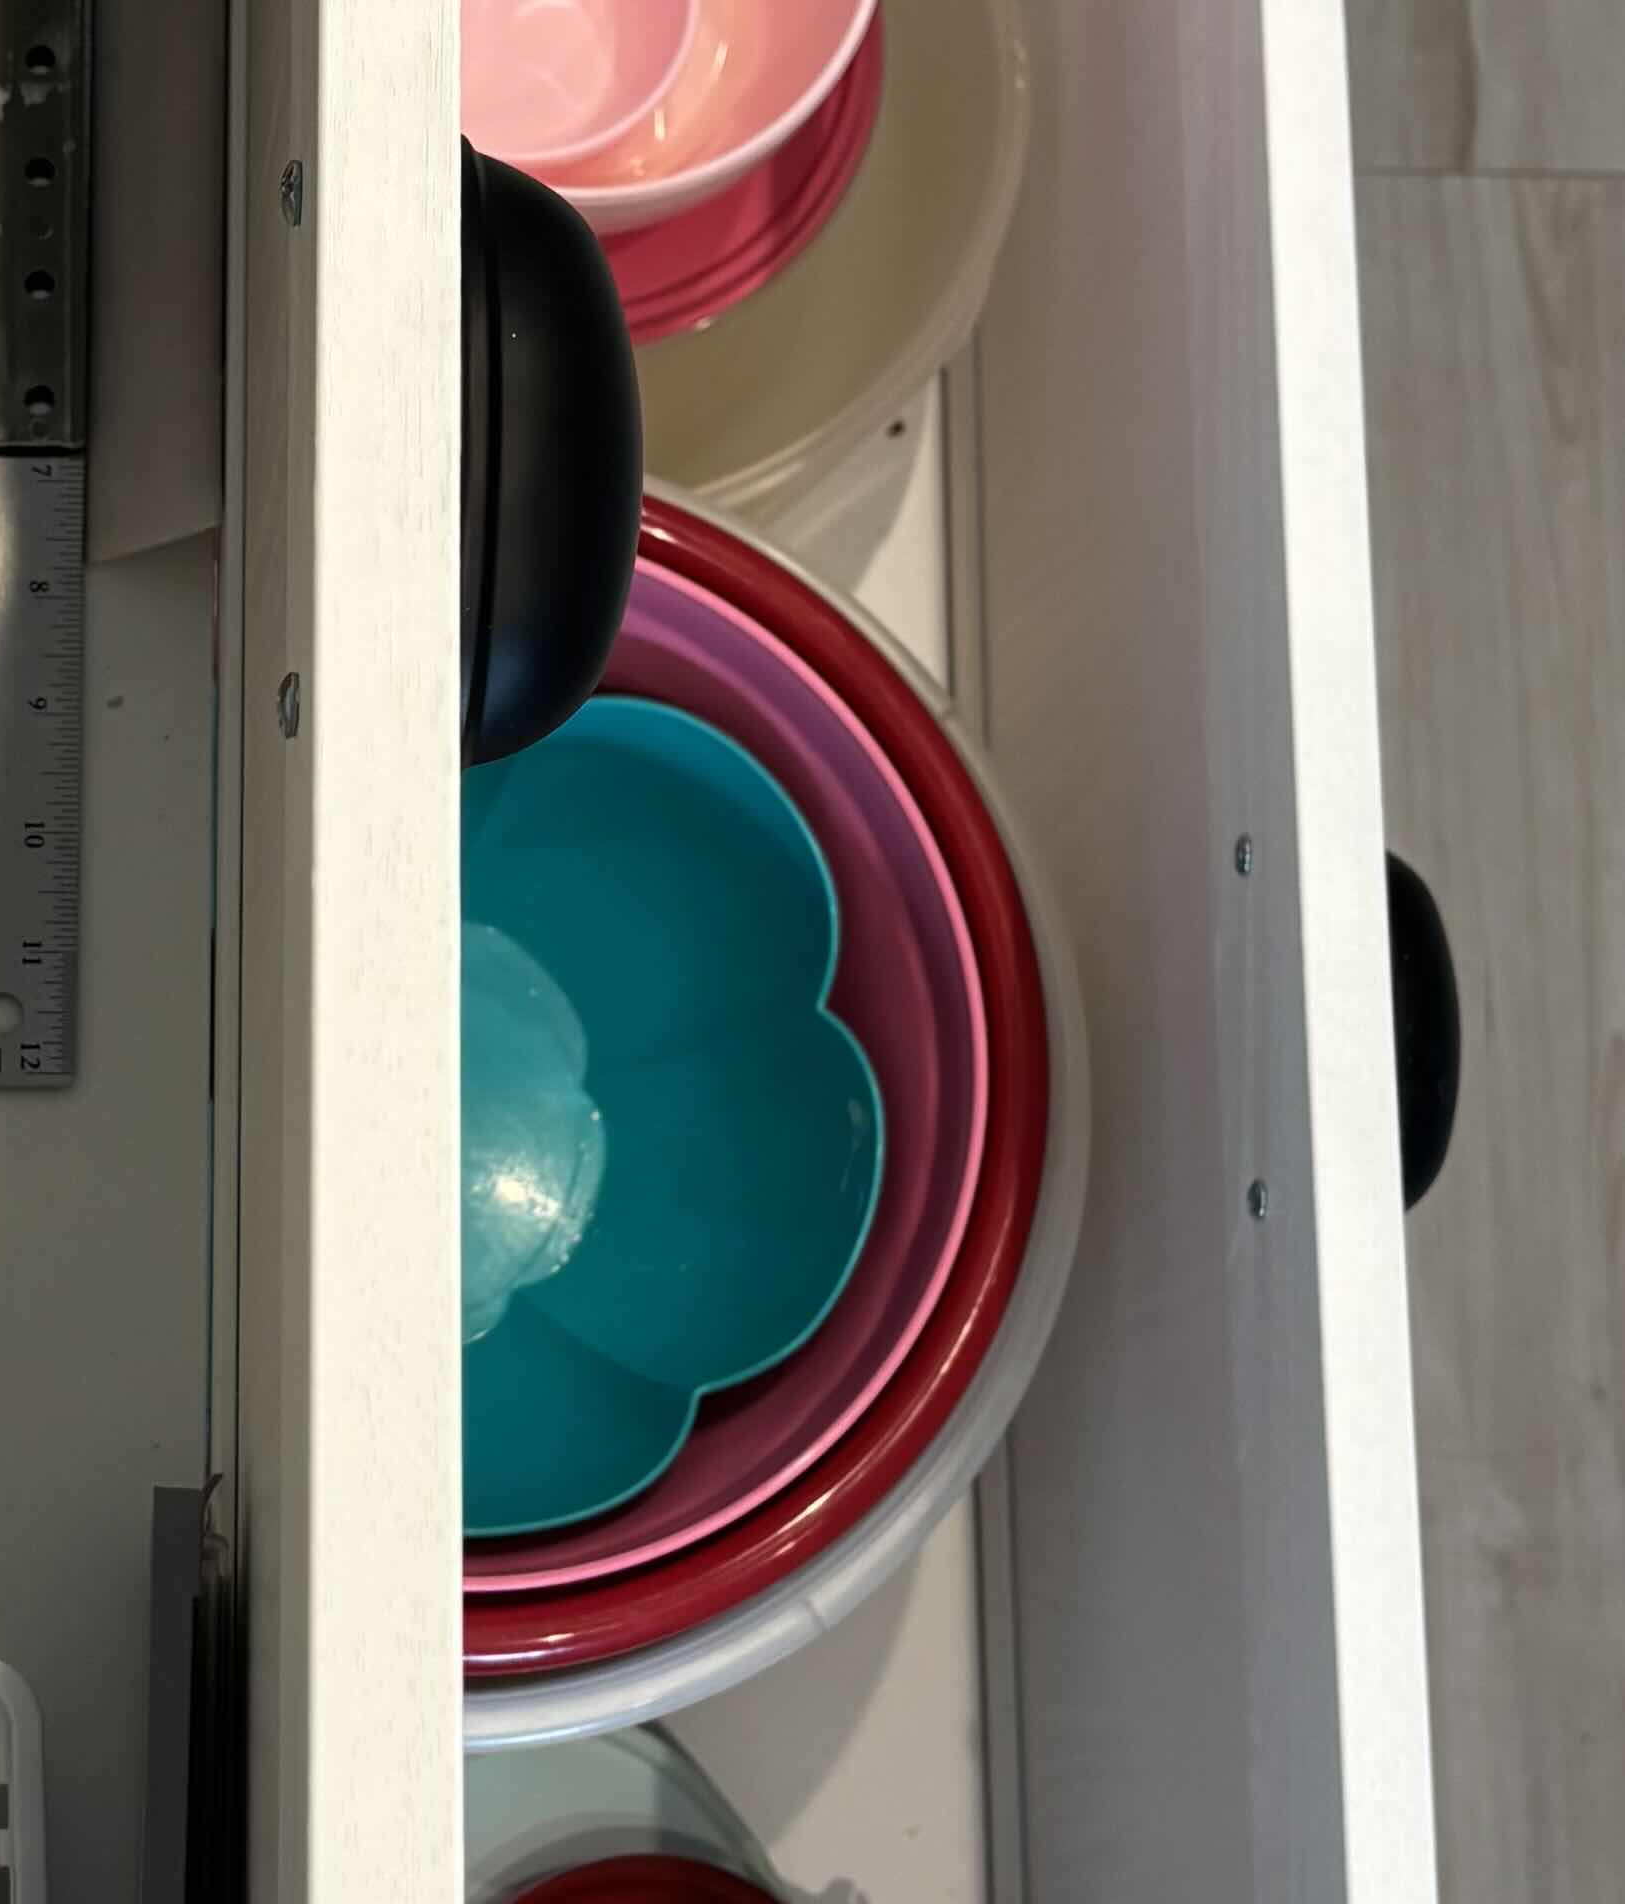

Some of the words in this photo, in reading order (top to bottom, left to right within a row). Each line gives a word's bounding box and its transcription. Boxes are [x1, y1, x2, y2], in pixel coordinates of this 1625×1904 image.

[30, 464, 52, 477] 7
[29, 580, 50, 593] 8
[27, 697, 47, 710] 9
[24, 822, 46, 848] 10
[22, 941, 42, 965] 11
[21, 1044, 41, 1070] 12
